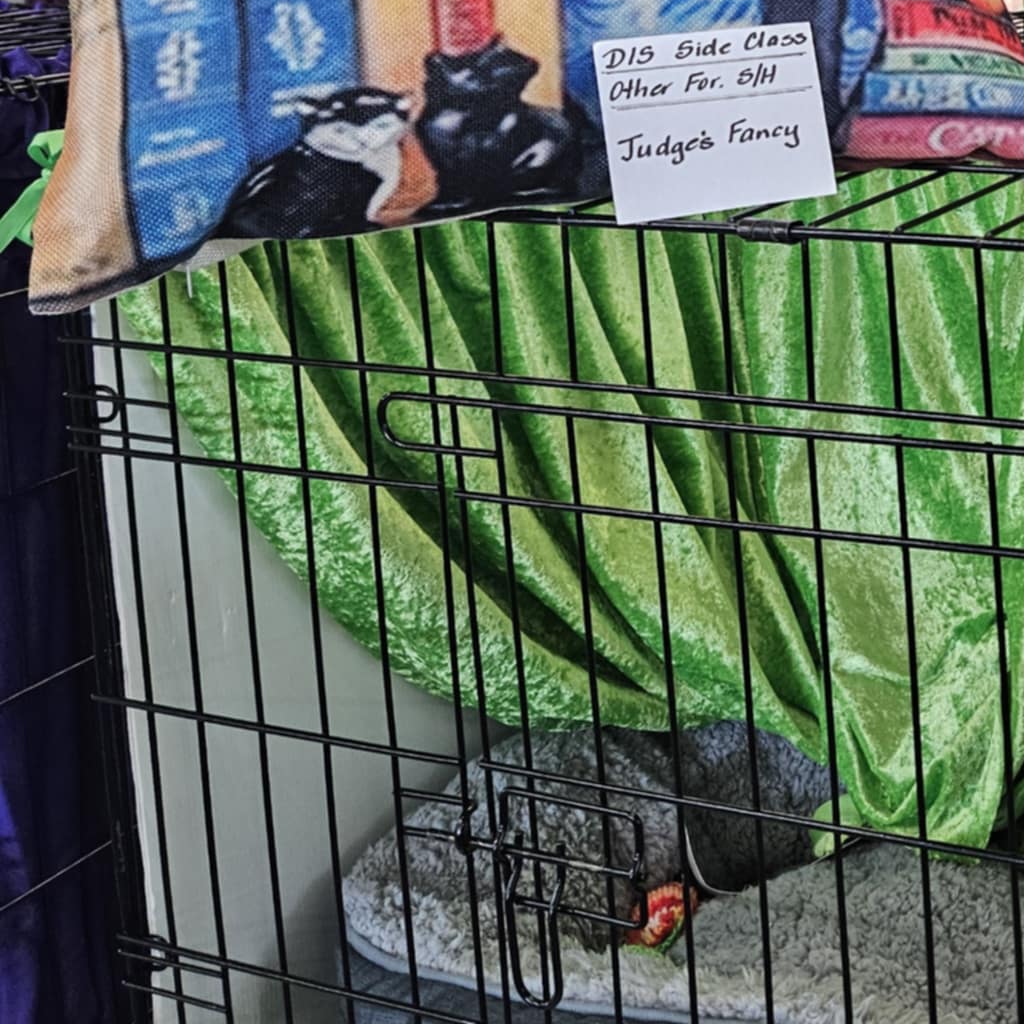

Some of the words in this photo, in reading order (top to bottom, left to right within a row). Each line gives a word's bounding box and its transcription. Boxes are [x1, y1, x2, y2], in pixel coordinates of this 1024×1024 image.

[674, 38, 732, 60] Side
[744, 31, 808, 51] Class
[609, 78, 673, 102] Other
[684, 71, 725, 93] For.
[736, 64, 777, 88] S/H
[617, 130, 715, 165] Judge's
[728, 118, 800, 148] Fancy
